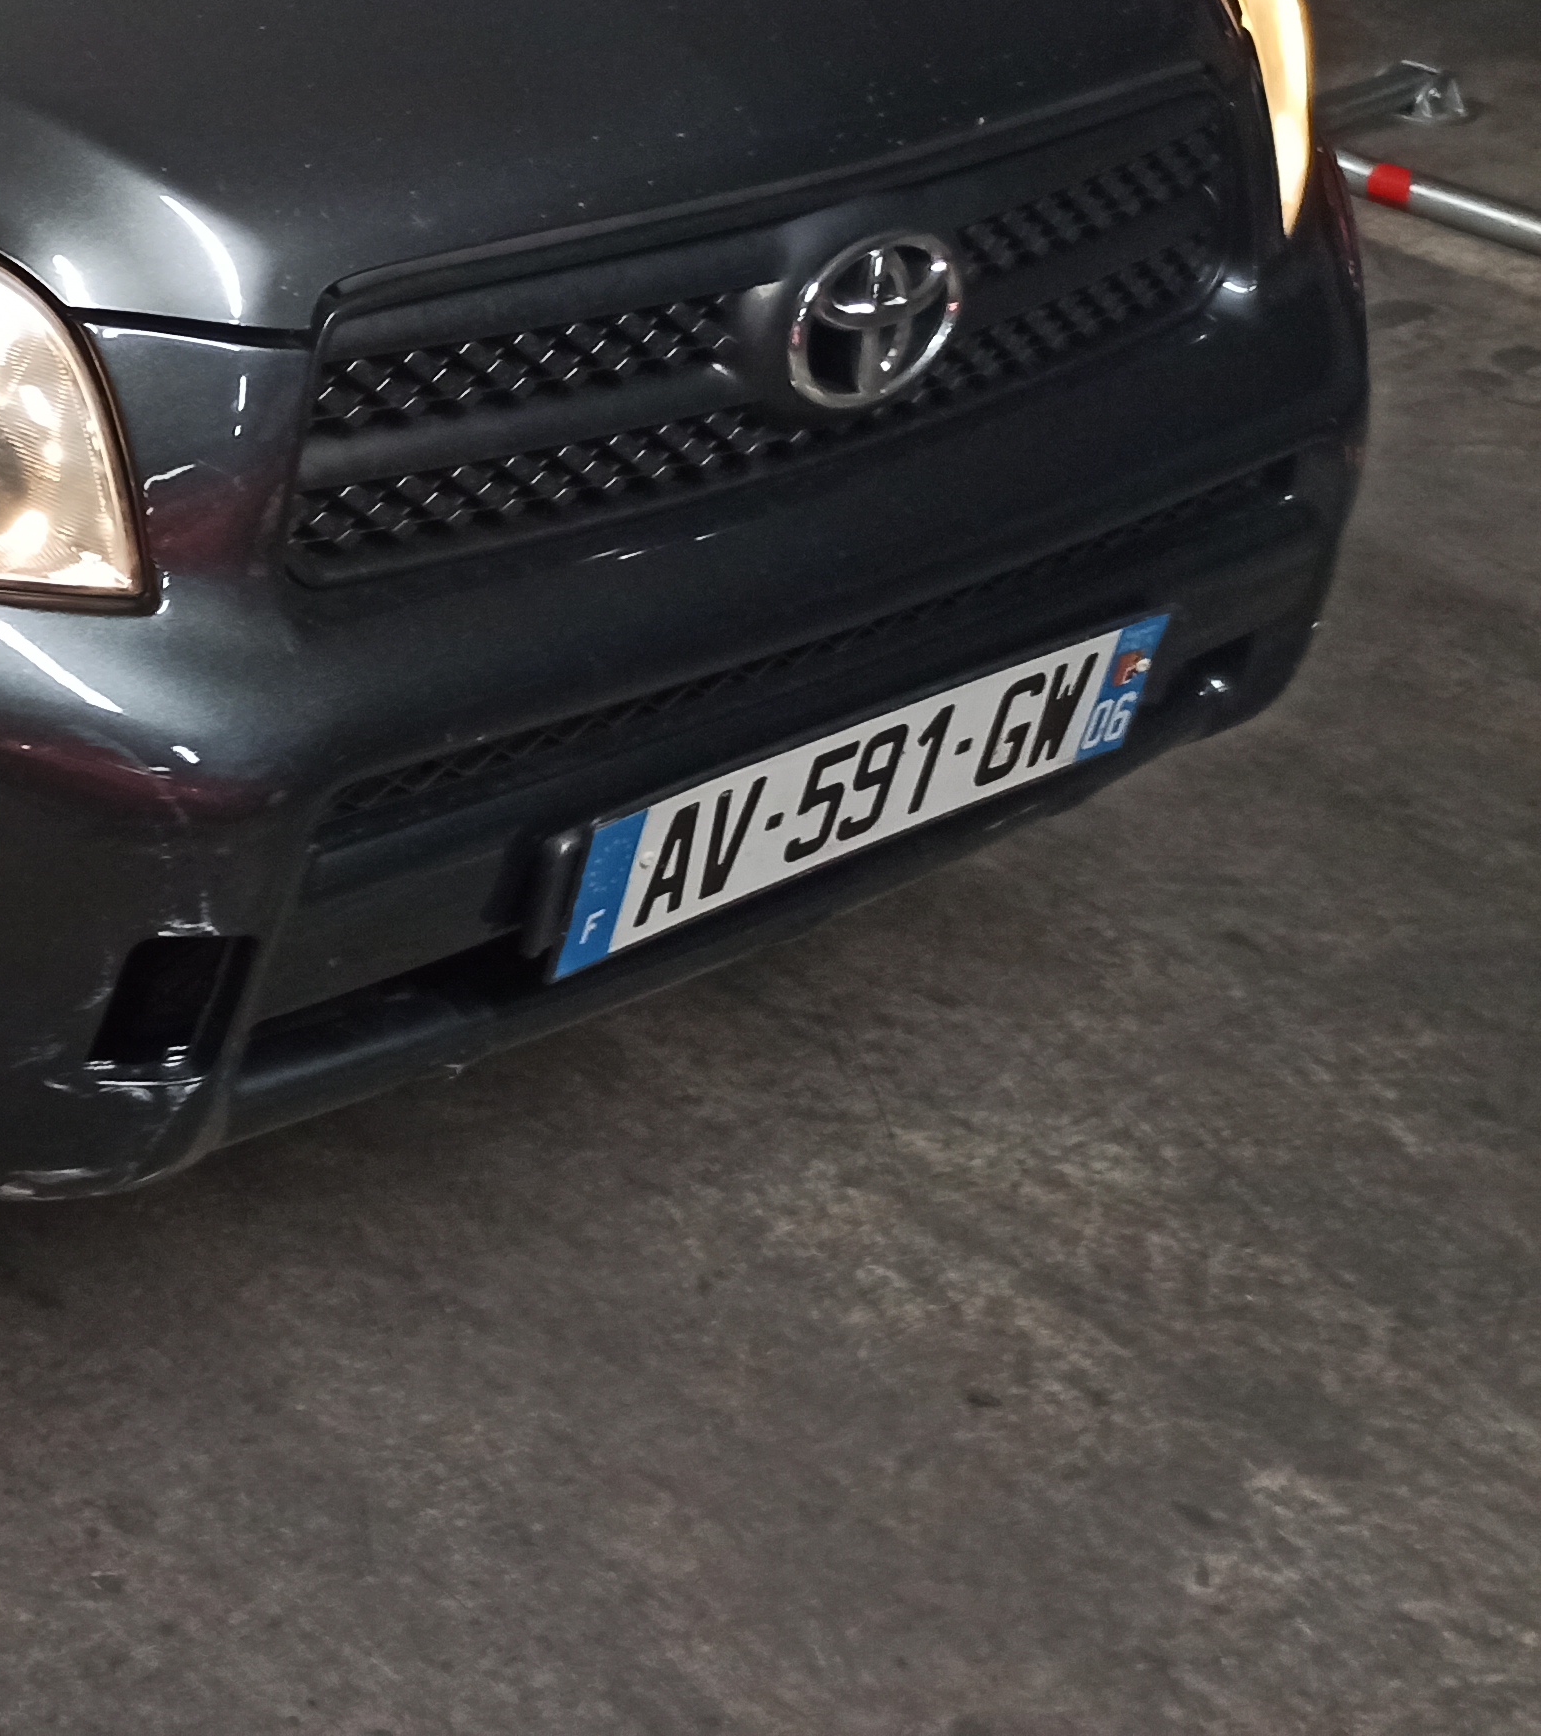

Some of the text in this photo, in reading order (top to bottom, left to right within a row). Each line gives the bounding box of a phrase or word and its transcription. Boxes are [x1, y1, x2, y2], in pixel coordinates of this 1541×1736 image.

[1080, 690, 1140, 751] 06
[632, 651, 1100, 928] AV-591-GW
[578, 907, 607, 945] F
